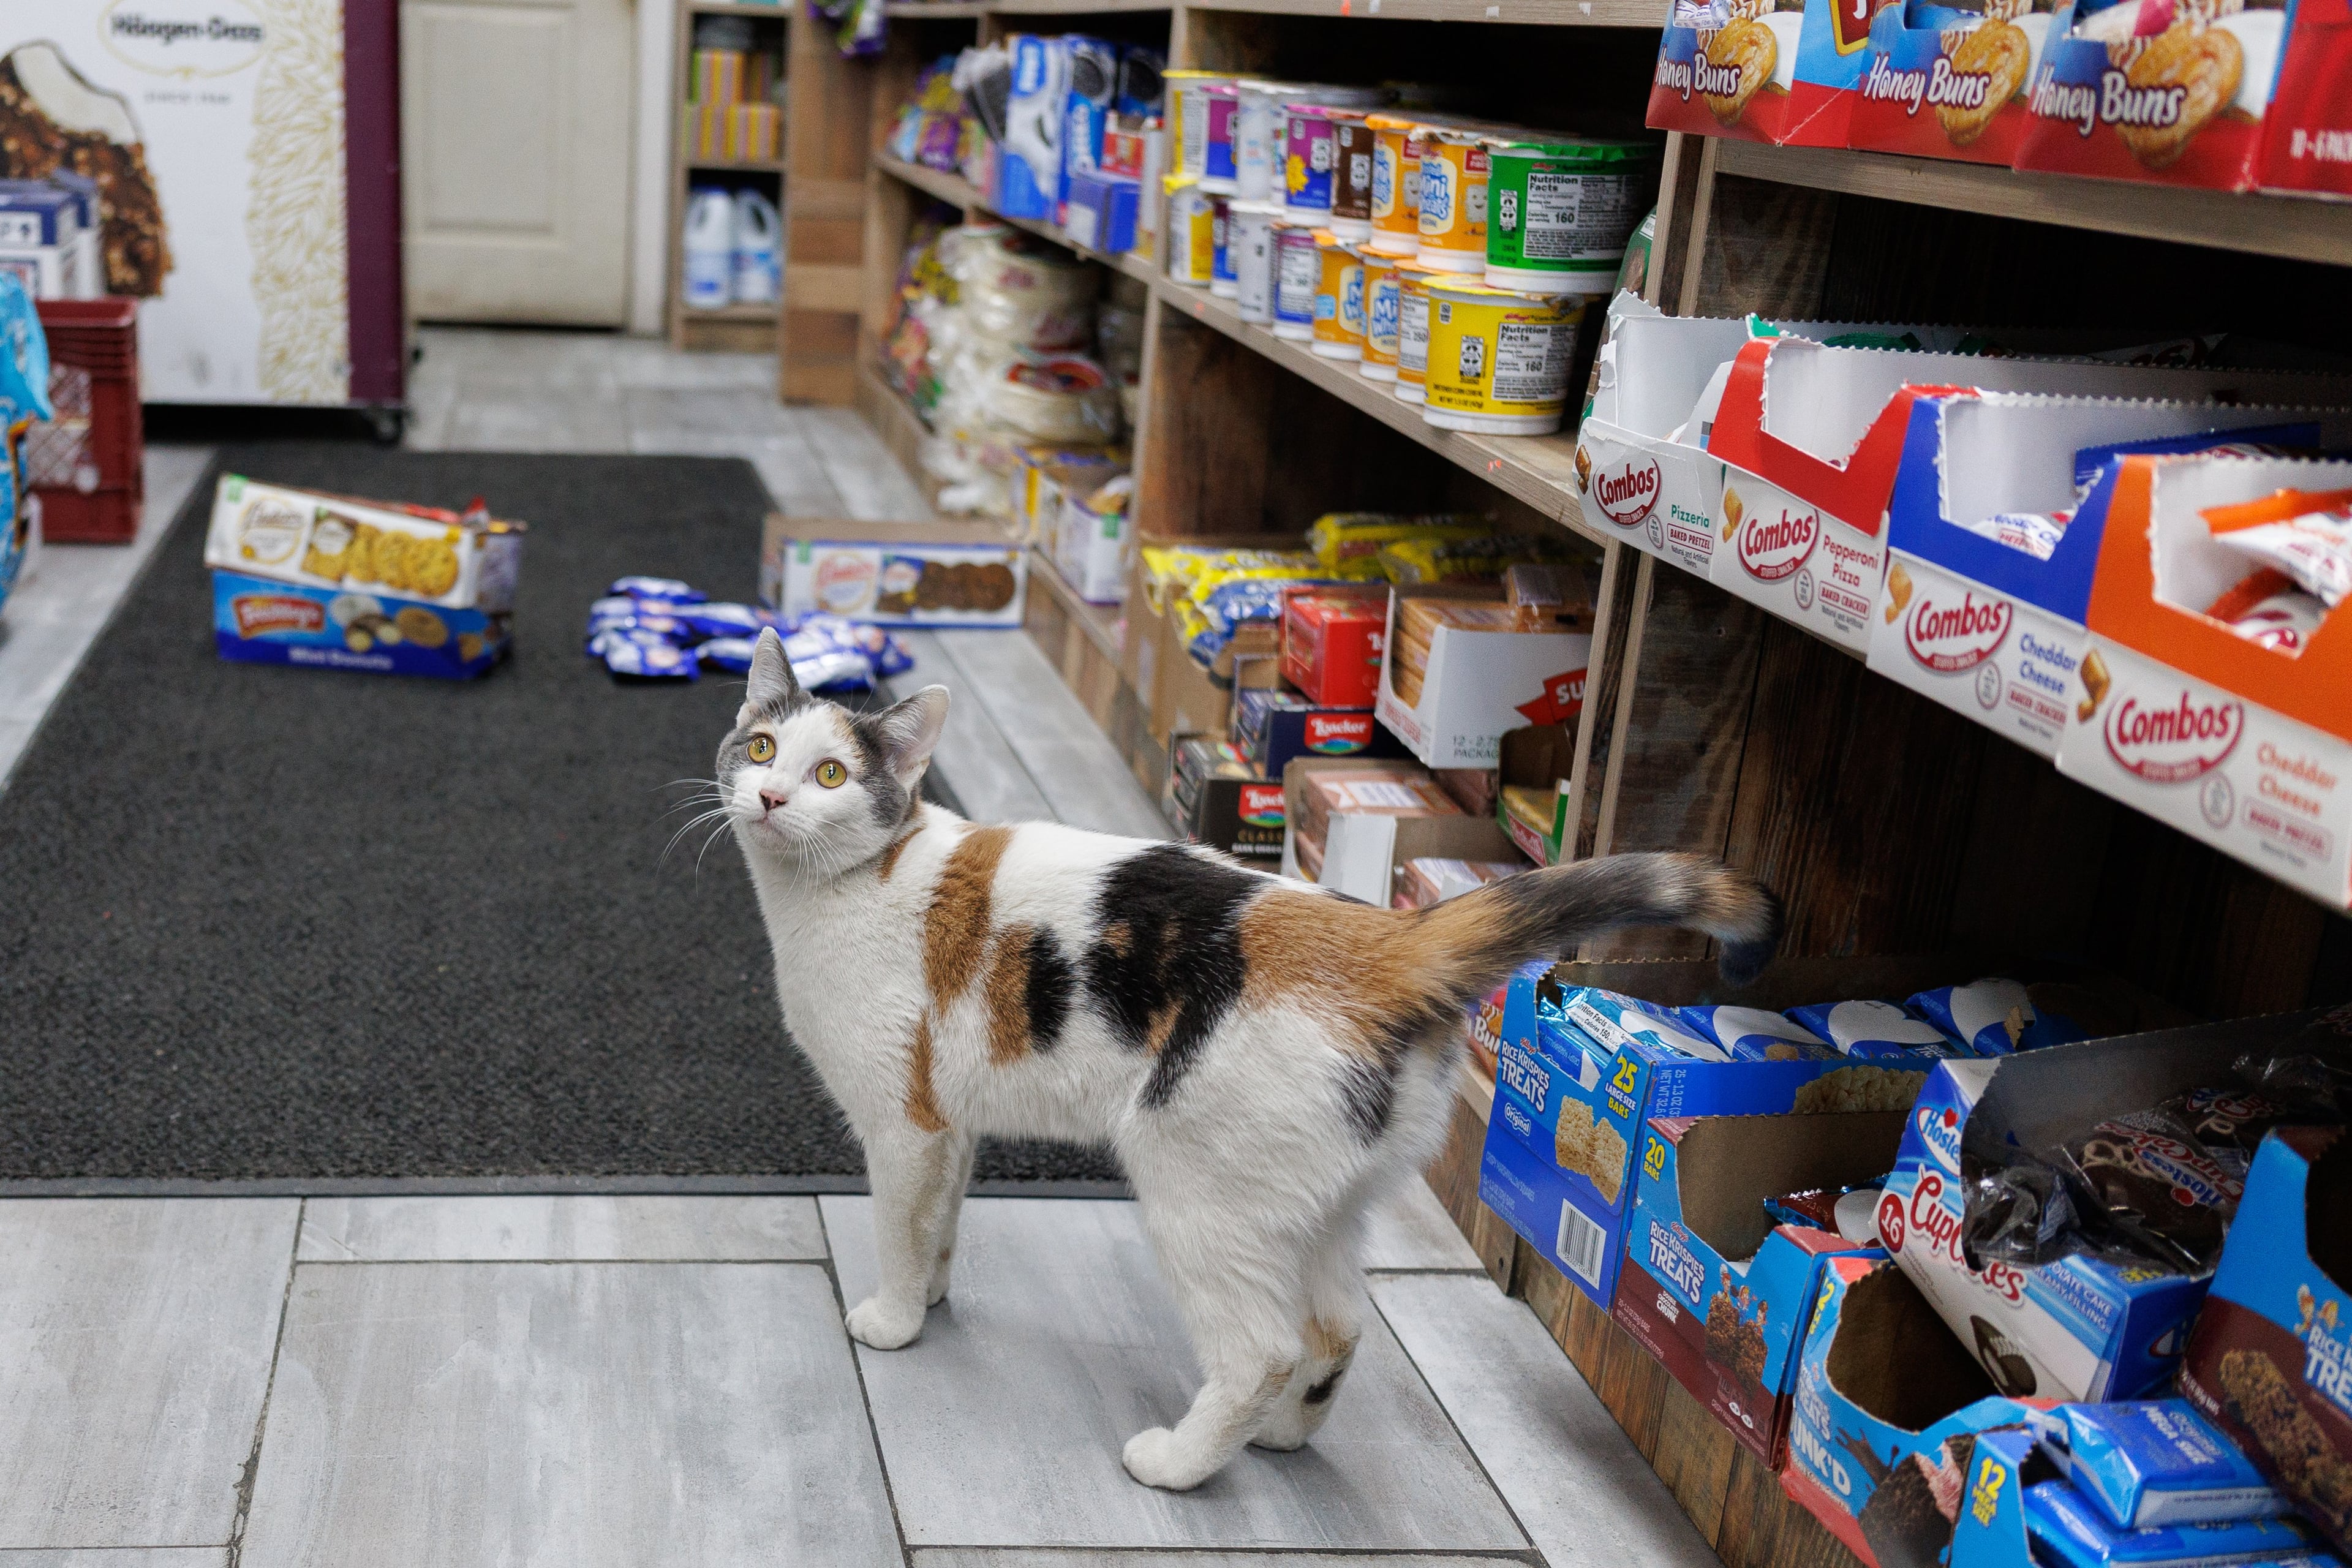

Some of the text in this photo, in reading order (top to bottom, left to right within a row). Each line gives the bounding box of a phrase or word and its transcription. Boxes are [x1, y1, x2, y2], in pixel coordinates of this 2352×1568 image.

[1656, 48, 1740, 101] Honey Buns
[1865, 55, 1989, 115] Honey Buns
[2031, 65, 2185, 137] Honey Buns
[1529, 183, 1558, 192] Facts
[1530, 175, 1578, 184] Nutrition
[1555, 213, 1575, 224] 160
[1501, 325, 1548, 334] Nutrition
[1526, 362, 1542, 372] 160
[1599, 464, 1654, 506] Combos
[1632, 508, 1644, 521] SNACKS
[1671, 504, 1709, 528] Pizzeria
[1670, 529, 1687, 542] BAKED
[1688, 534, 1710, 549] PRETZEL
[1746, 509, 1812, 556] Combos
[1823, 534, 1880, 570] Pepperoni
[1832, 562, 1860, 587] Pizza
[1822, 587, 1840, 603] BAKED
[1841, 595, 1868, 615] CRACKER
[1916, 590, 2006, 642] Combos
[2019, 633, 2077, 672] Cheddar
[2019, 660, 2065, 695] Cheese
[1555, 680, 1585, 705] SU
[2118, 691, 2231, 746] Combos
[1453, 748, 1499, 760] PACKAG
[1237, 829, 1284, 843] CLASS
[1580, 1003, 1607, 1027] rition Facts
[1585, 1019, 1600, 1033] Calories
[1502, 1041, 1550, 1090] RICE KRISPIES
[1613, 1057, 1638, 1094] 25
[1675, 1069, 1687, 1078] 25
[1501, 1057, 1545, 1112] TREATS
[1605, 1083, 1637, 1110] LARGE SIZE
[1655, 1070, 1673, 1113] NET WT 32.6
[1672, 1085, 1685, 1095] 1.3
[1608, 1096, 1630, 1119] BARS
[1671, 1096, 1683, 1106] OZ
[1505, 1102, 1531, 1137] Original
[1645, 1137, 1665, 1169] 20
[1643, 1160, 1660, 1182] BARS
[2140, 1148, 2225, 1206] Hostess
[1882, 1204, 1901, 1245] 16
[1650, 1221, 1705, 1282] RICE KRISPIES
[1649, 1238, 1700, 1304] TREATS
[1656, 1299, 1676, 1324] CHUNK
[1662, 1291, 1677, 1306] DOUBLE
[2083, 1289, 2113, 1316] CAKE
[2305, 1349, 2352, 1411] TRE
[1792, 1414, 1850, 1496] UNK'D
[1978, 1457, 2007, 1501] 12
